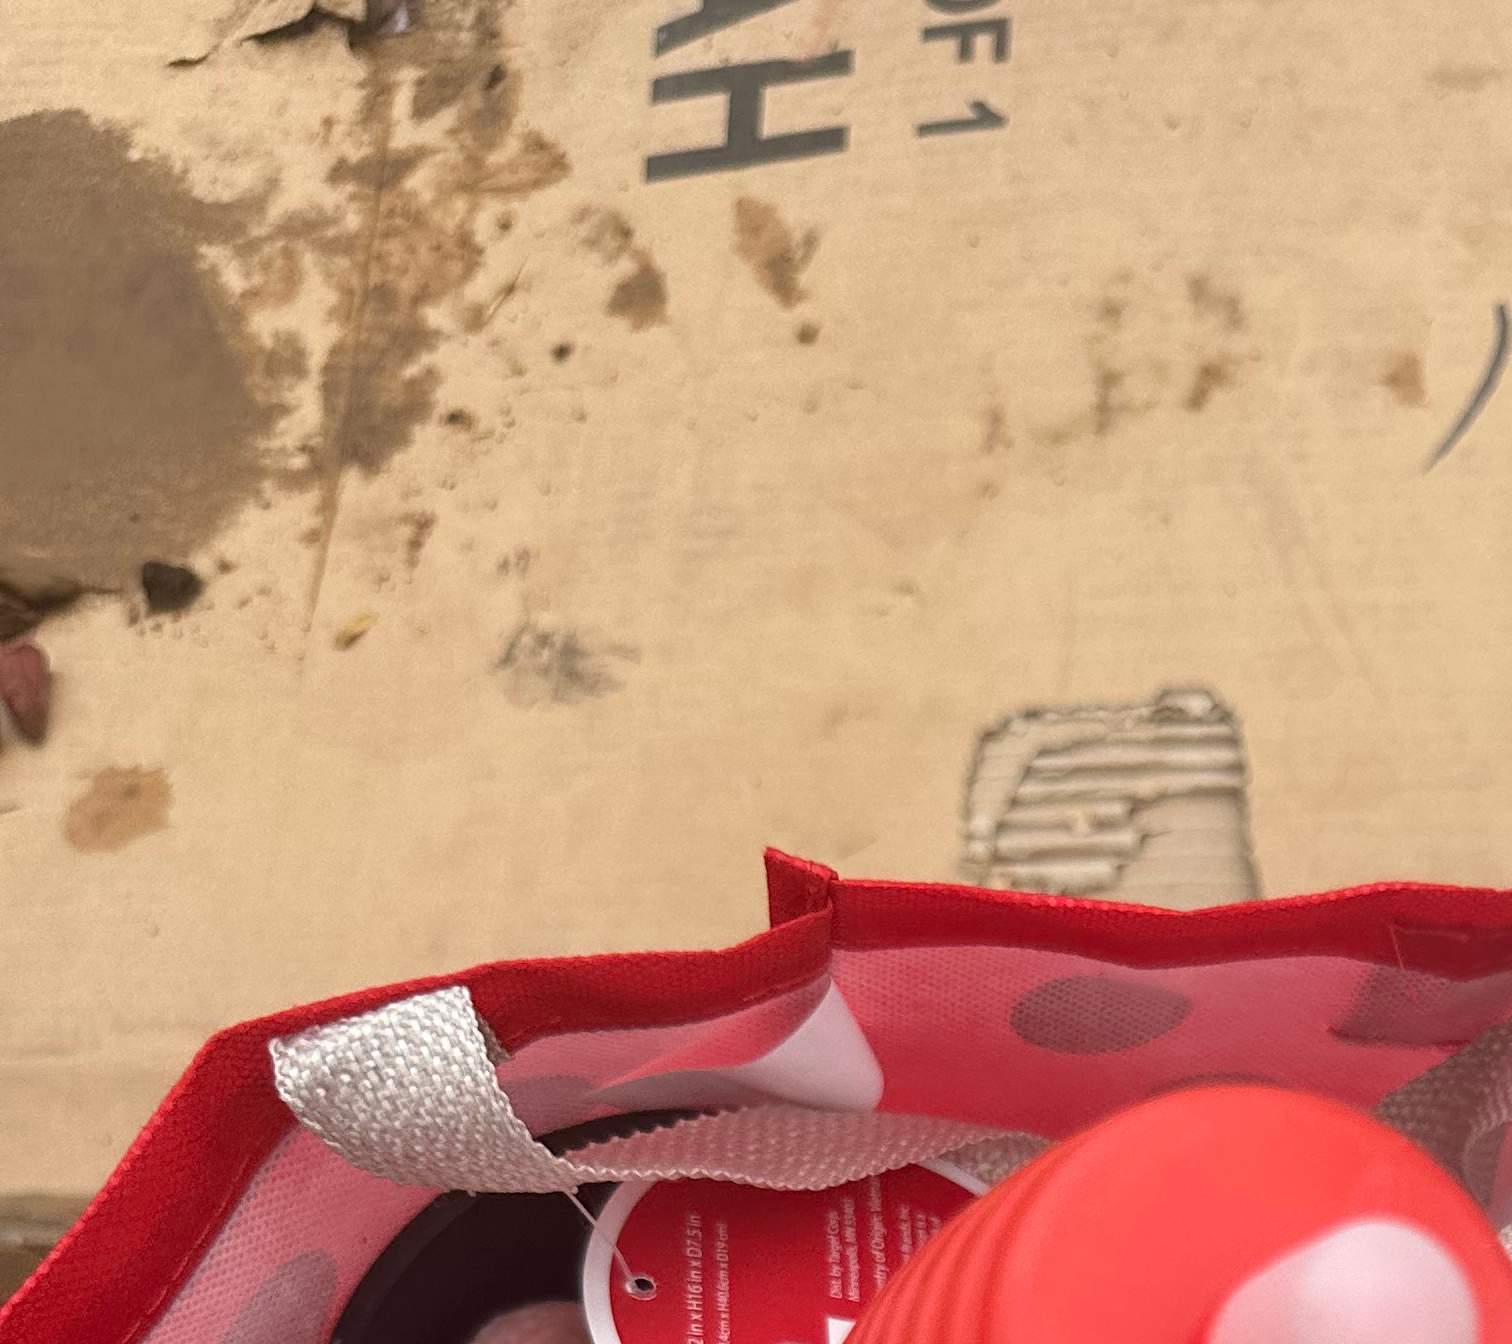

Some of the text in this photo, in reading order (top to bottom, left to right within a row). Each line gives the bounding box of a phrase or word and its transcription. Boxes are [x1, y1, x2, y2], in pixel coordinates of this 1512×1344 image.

[916, 0, 1012, 138] F 1
[687, 1215, 702, 1228] in
[686, 1229, 703, 1258] D7.5
[686, 1270, 703, 1283] in
[686, 1284, 704, 1311] H16
[686, 1323, 703, 1336] in
